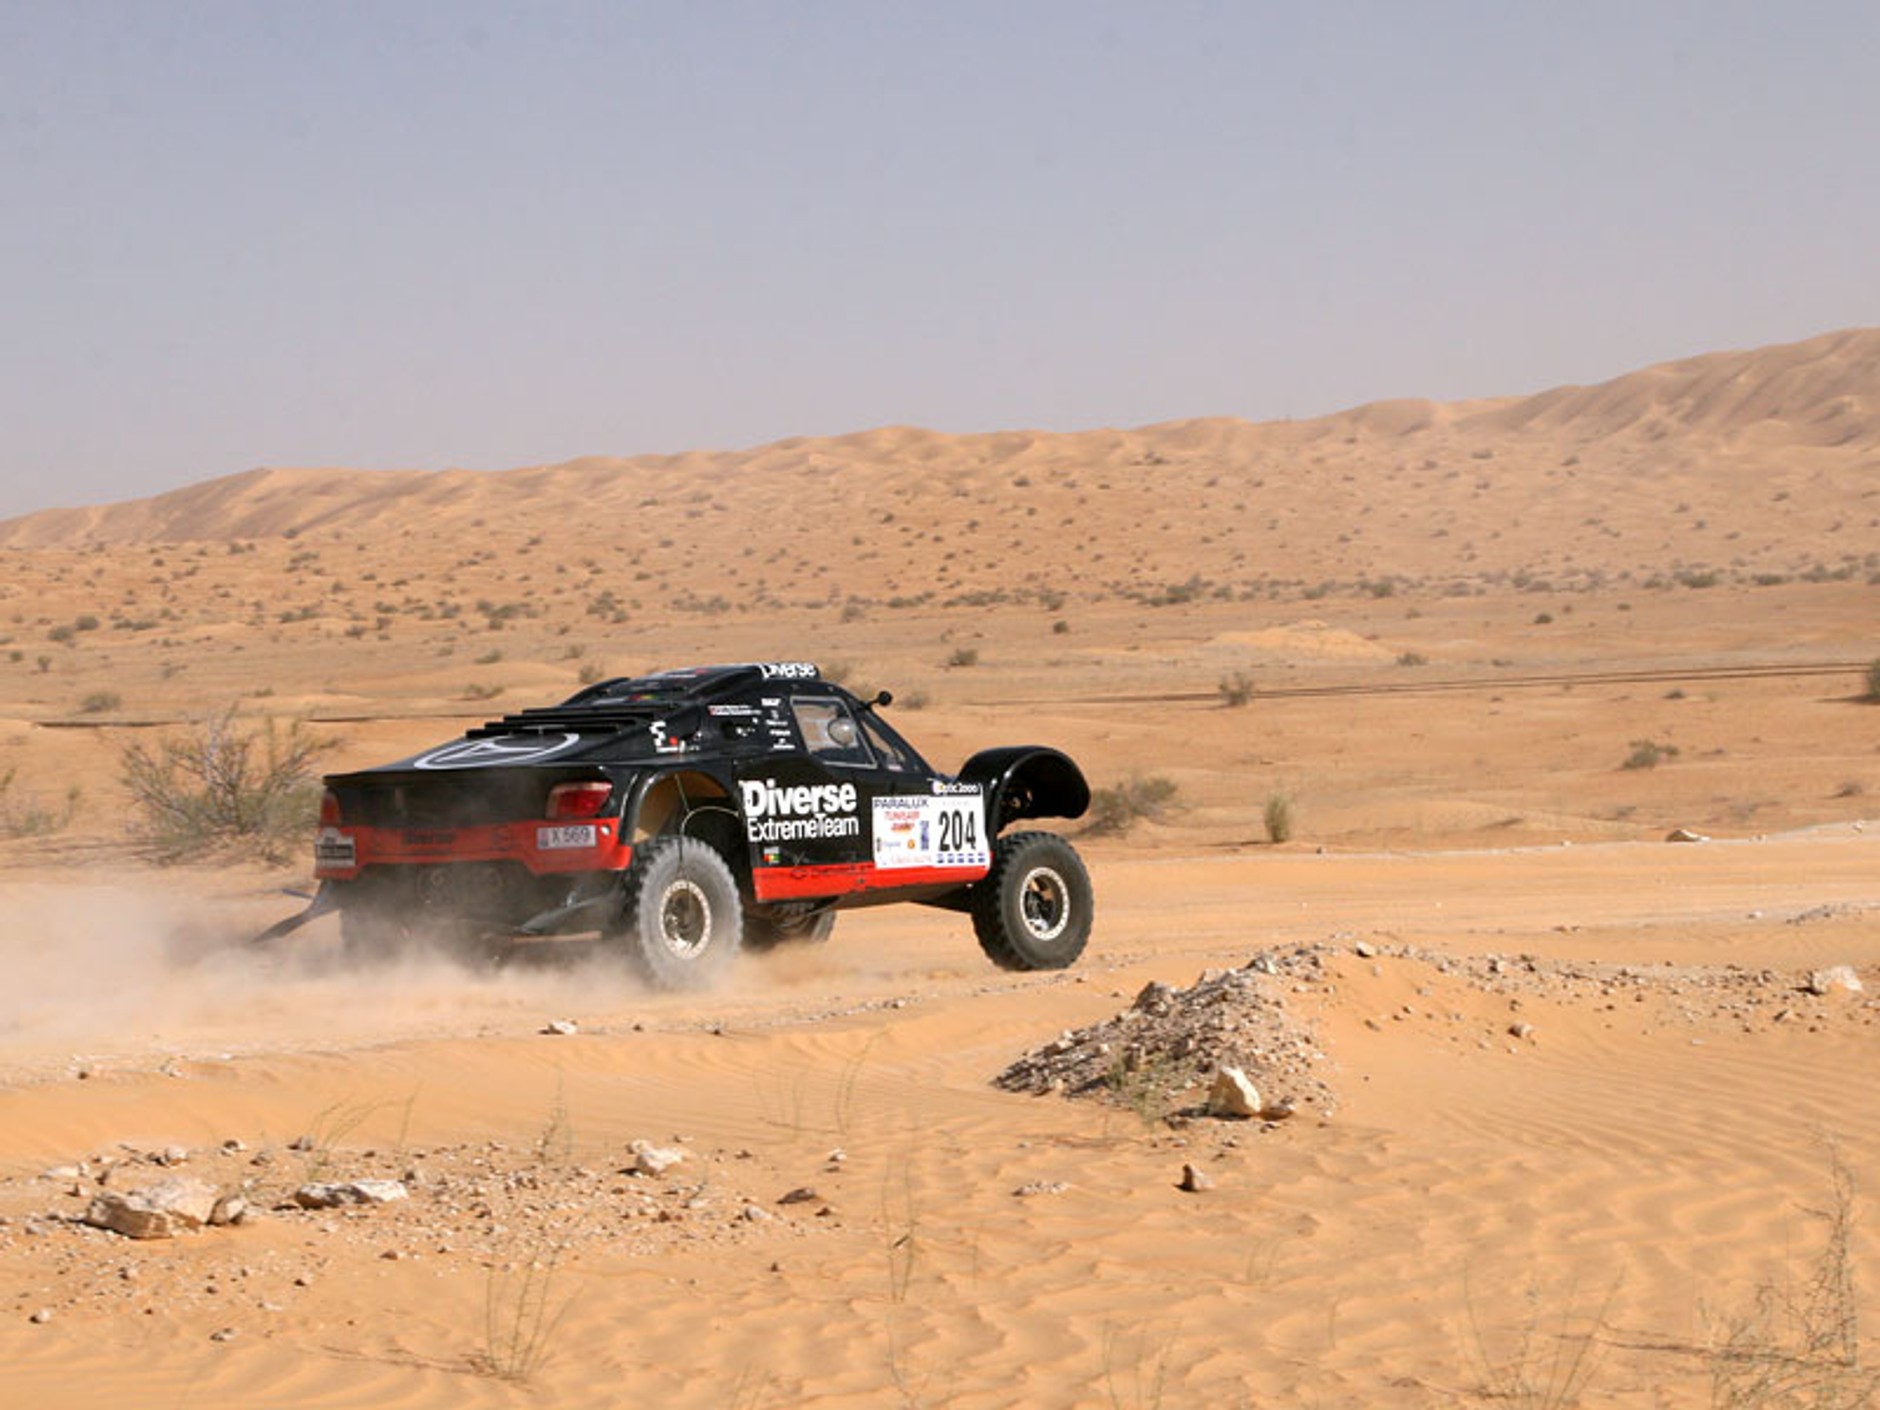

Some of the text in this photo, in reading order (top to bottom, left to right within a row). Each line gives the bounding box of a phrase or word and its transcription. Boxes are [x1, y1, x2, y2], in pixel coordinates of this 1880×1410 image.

[738, 778, 857, 816] Diverse
[873, 798, 929, 809] PARALUX
[564, 826, 591, 842] 569
[938, 809, 977, 852] 204
